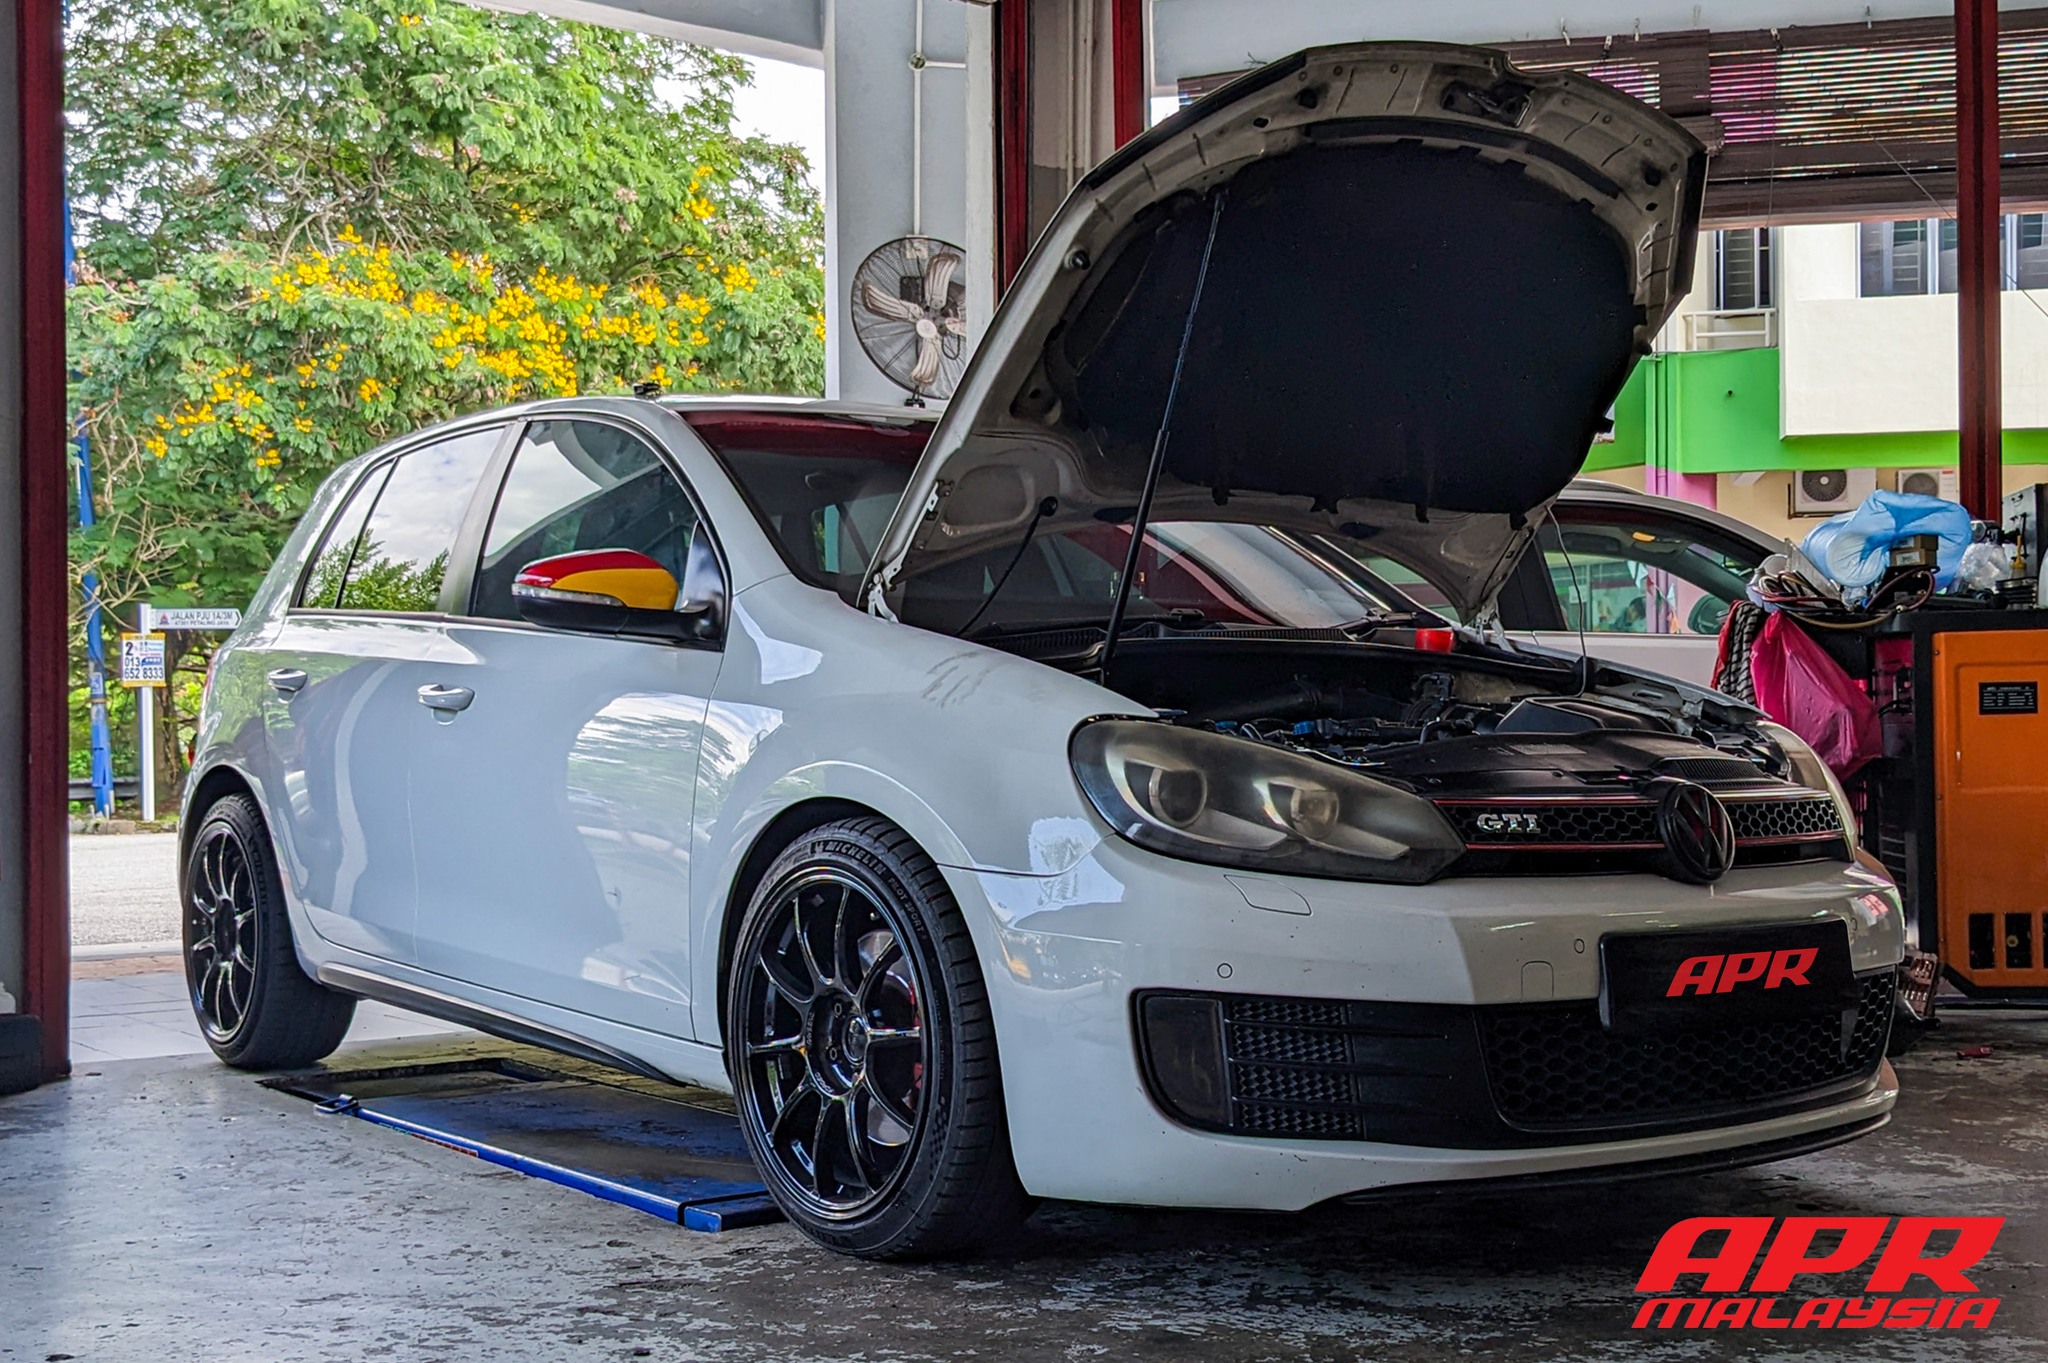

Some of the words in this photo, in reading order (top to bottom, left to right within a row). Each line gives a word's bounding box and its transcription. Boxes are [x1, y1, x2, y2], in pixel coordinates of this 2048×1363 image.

[170, 611, 196, 620] JALAN
[197, 611, 211, 620] PJU
[124, 656, 141, 667] 013
[124, 667, 140, 679] 652
[142, 667, 164, 679] 8333
[1476, 812, 1541, 835] GTI
[824, 841, 887, 876] MICHELIN
[887, 876, 908, 901] PILOT
[904, 902, 924, 933] SPORT
